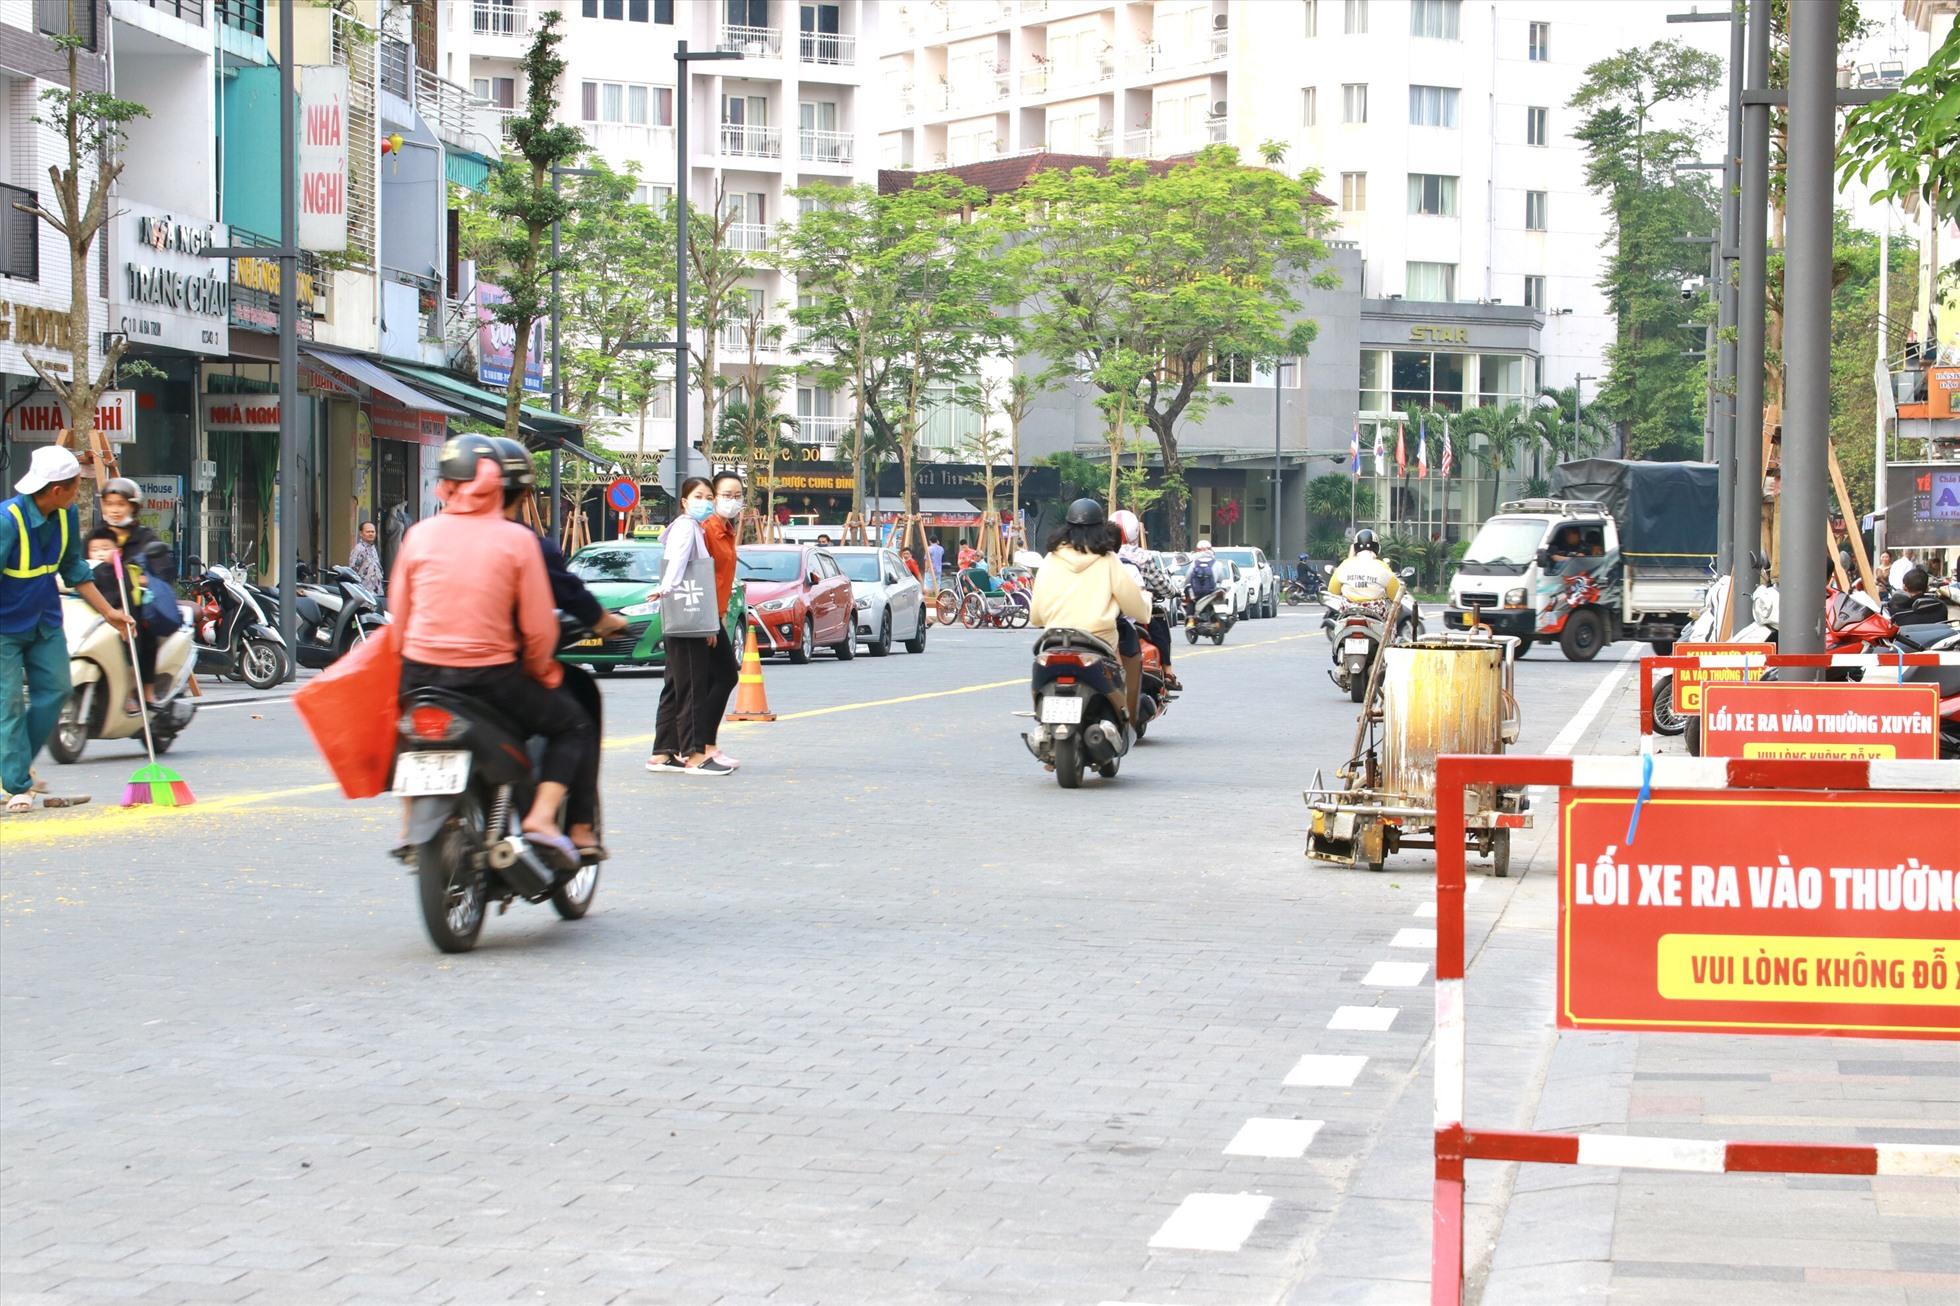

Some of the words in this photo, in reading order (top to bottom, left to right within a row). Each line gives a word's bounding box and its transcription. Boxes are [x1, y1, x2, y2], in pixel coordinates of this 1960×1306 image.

[306, 93, 341, 146] NHÀ
[303, 157, 344, 215] NGHỈ
[140, 215, 176, 251] NHÀ
[127, 262, 182, 308] TRANG
[14, 303, 73, 352] HOTE
[1409, 326, 1469, 343] STAR
[20, 401, 64, 431] NHÀ
[72, 398, 122, 431] GHỈ
[209, 402, 242, 425] NHÀ
[147, 482, 173, 494] House
[1680, 670, 1692, 681] RA
[1709, 706, 1732, 732] LỐI
[1735, 713, 1754, 732] XE
[1758, 714, 1778, 732] RA
[1781, 709, 1813, 733] VÀO
[1816, 710, 1878, 734] THƯỜNG
[1881, 711, 1932, 734] XUYÊN
[1575, 845, 1629, 905] LỐI
[1636, 865, 1682, 906] XE
[1691, 865, 1741, 907] RA
[1747, 855, 1822, 909] VÀO
[1829, 858, 1960, 912] THƯỜN
[1691, 955, 1734, 984] VUI
[1742, 948, 1808, 986] LÒNG
[1816, 951, 1905, 989] KHÔNG
[1912, 946, 1948, 990] ĐỖ
